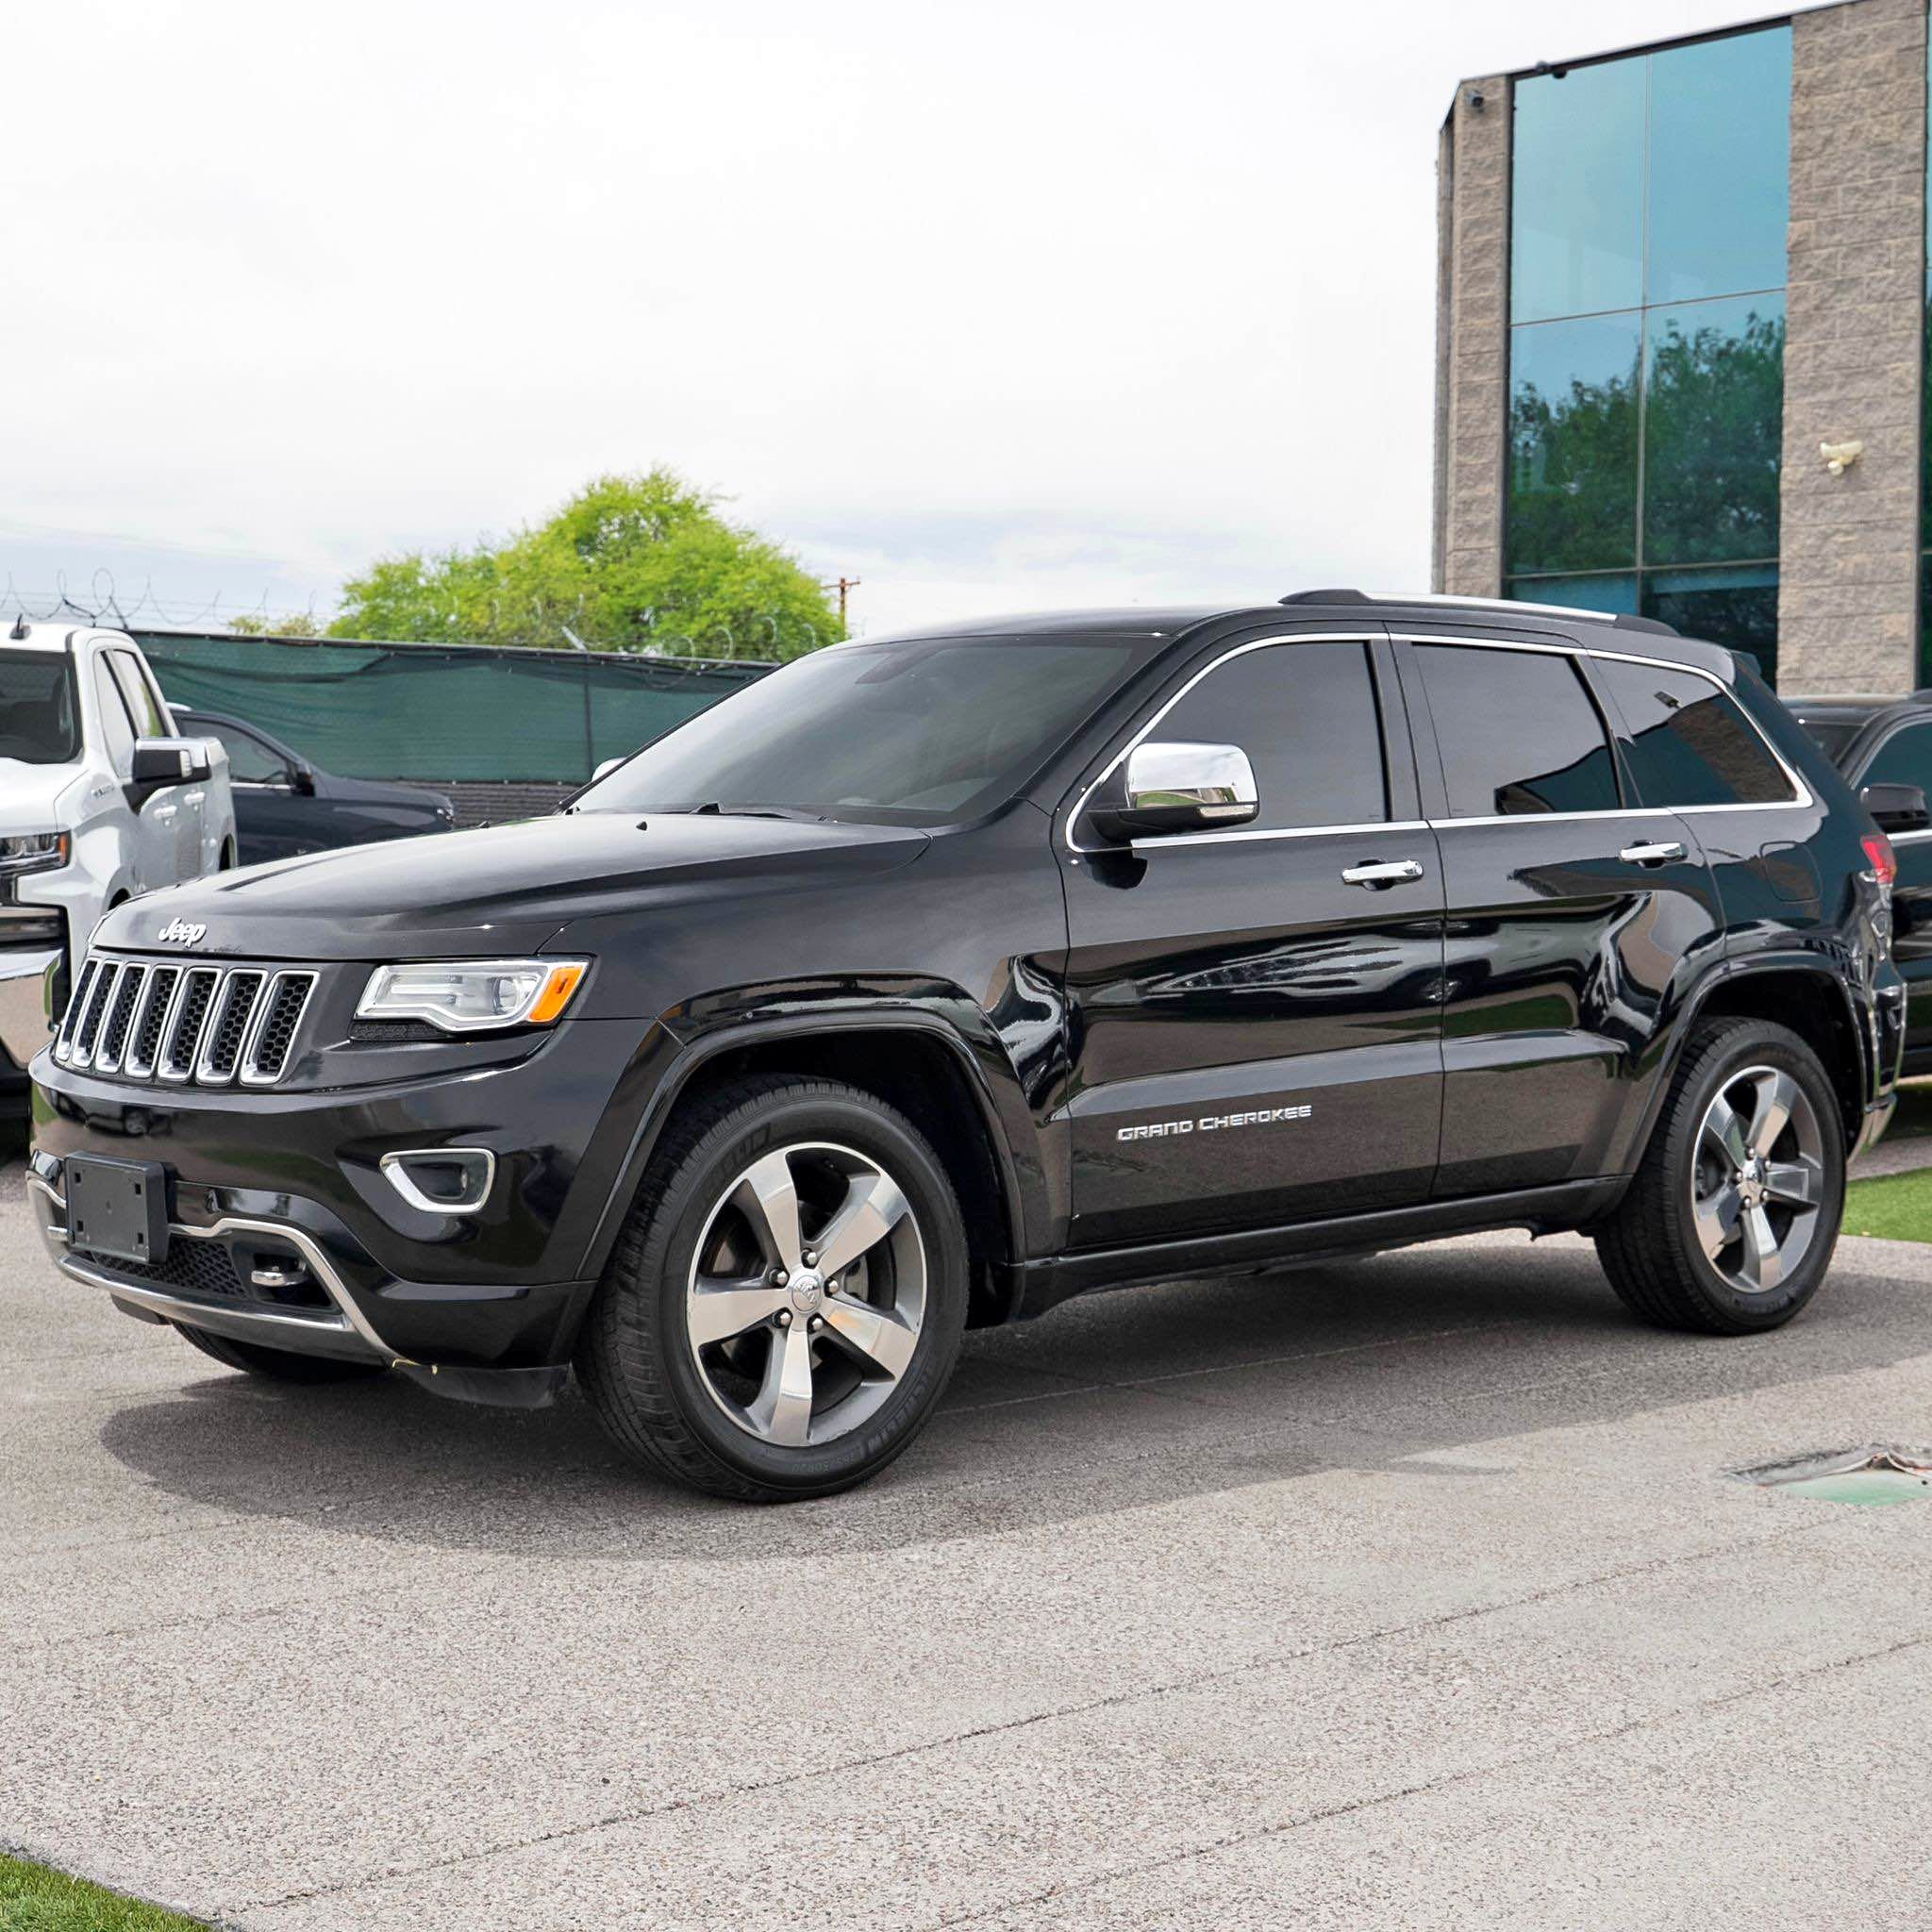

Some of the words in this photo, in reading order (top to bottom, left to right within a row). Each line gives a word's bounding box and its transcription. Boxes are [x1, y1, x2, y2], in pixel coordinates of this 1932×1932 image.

[158, 917, 207, 948] Jeep
[1117, 1120, 1193, 1141] GRAND
[1198, 1105, 1312, 1131] CHEROKEE
